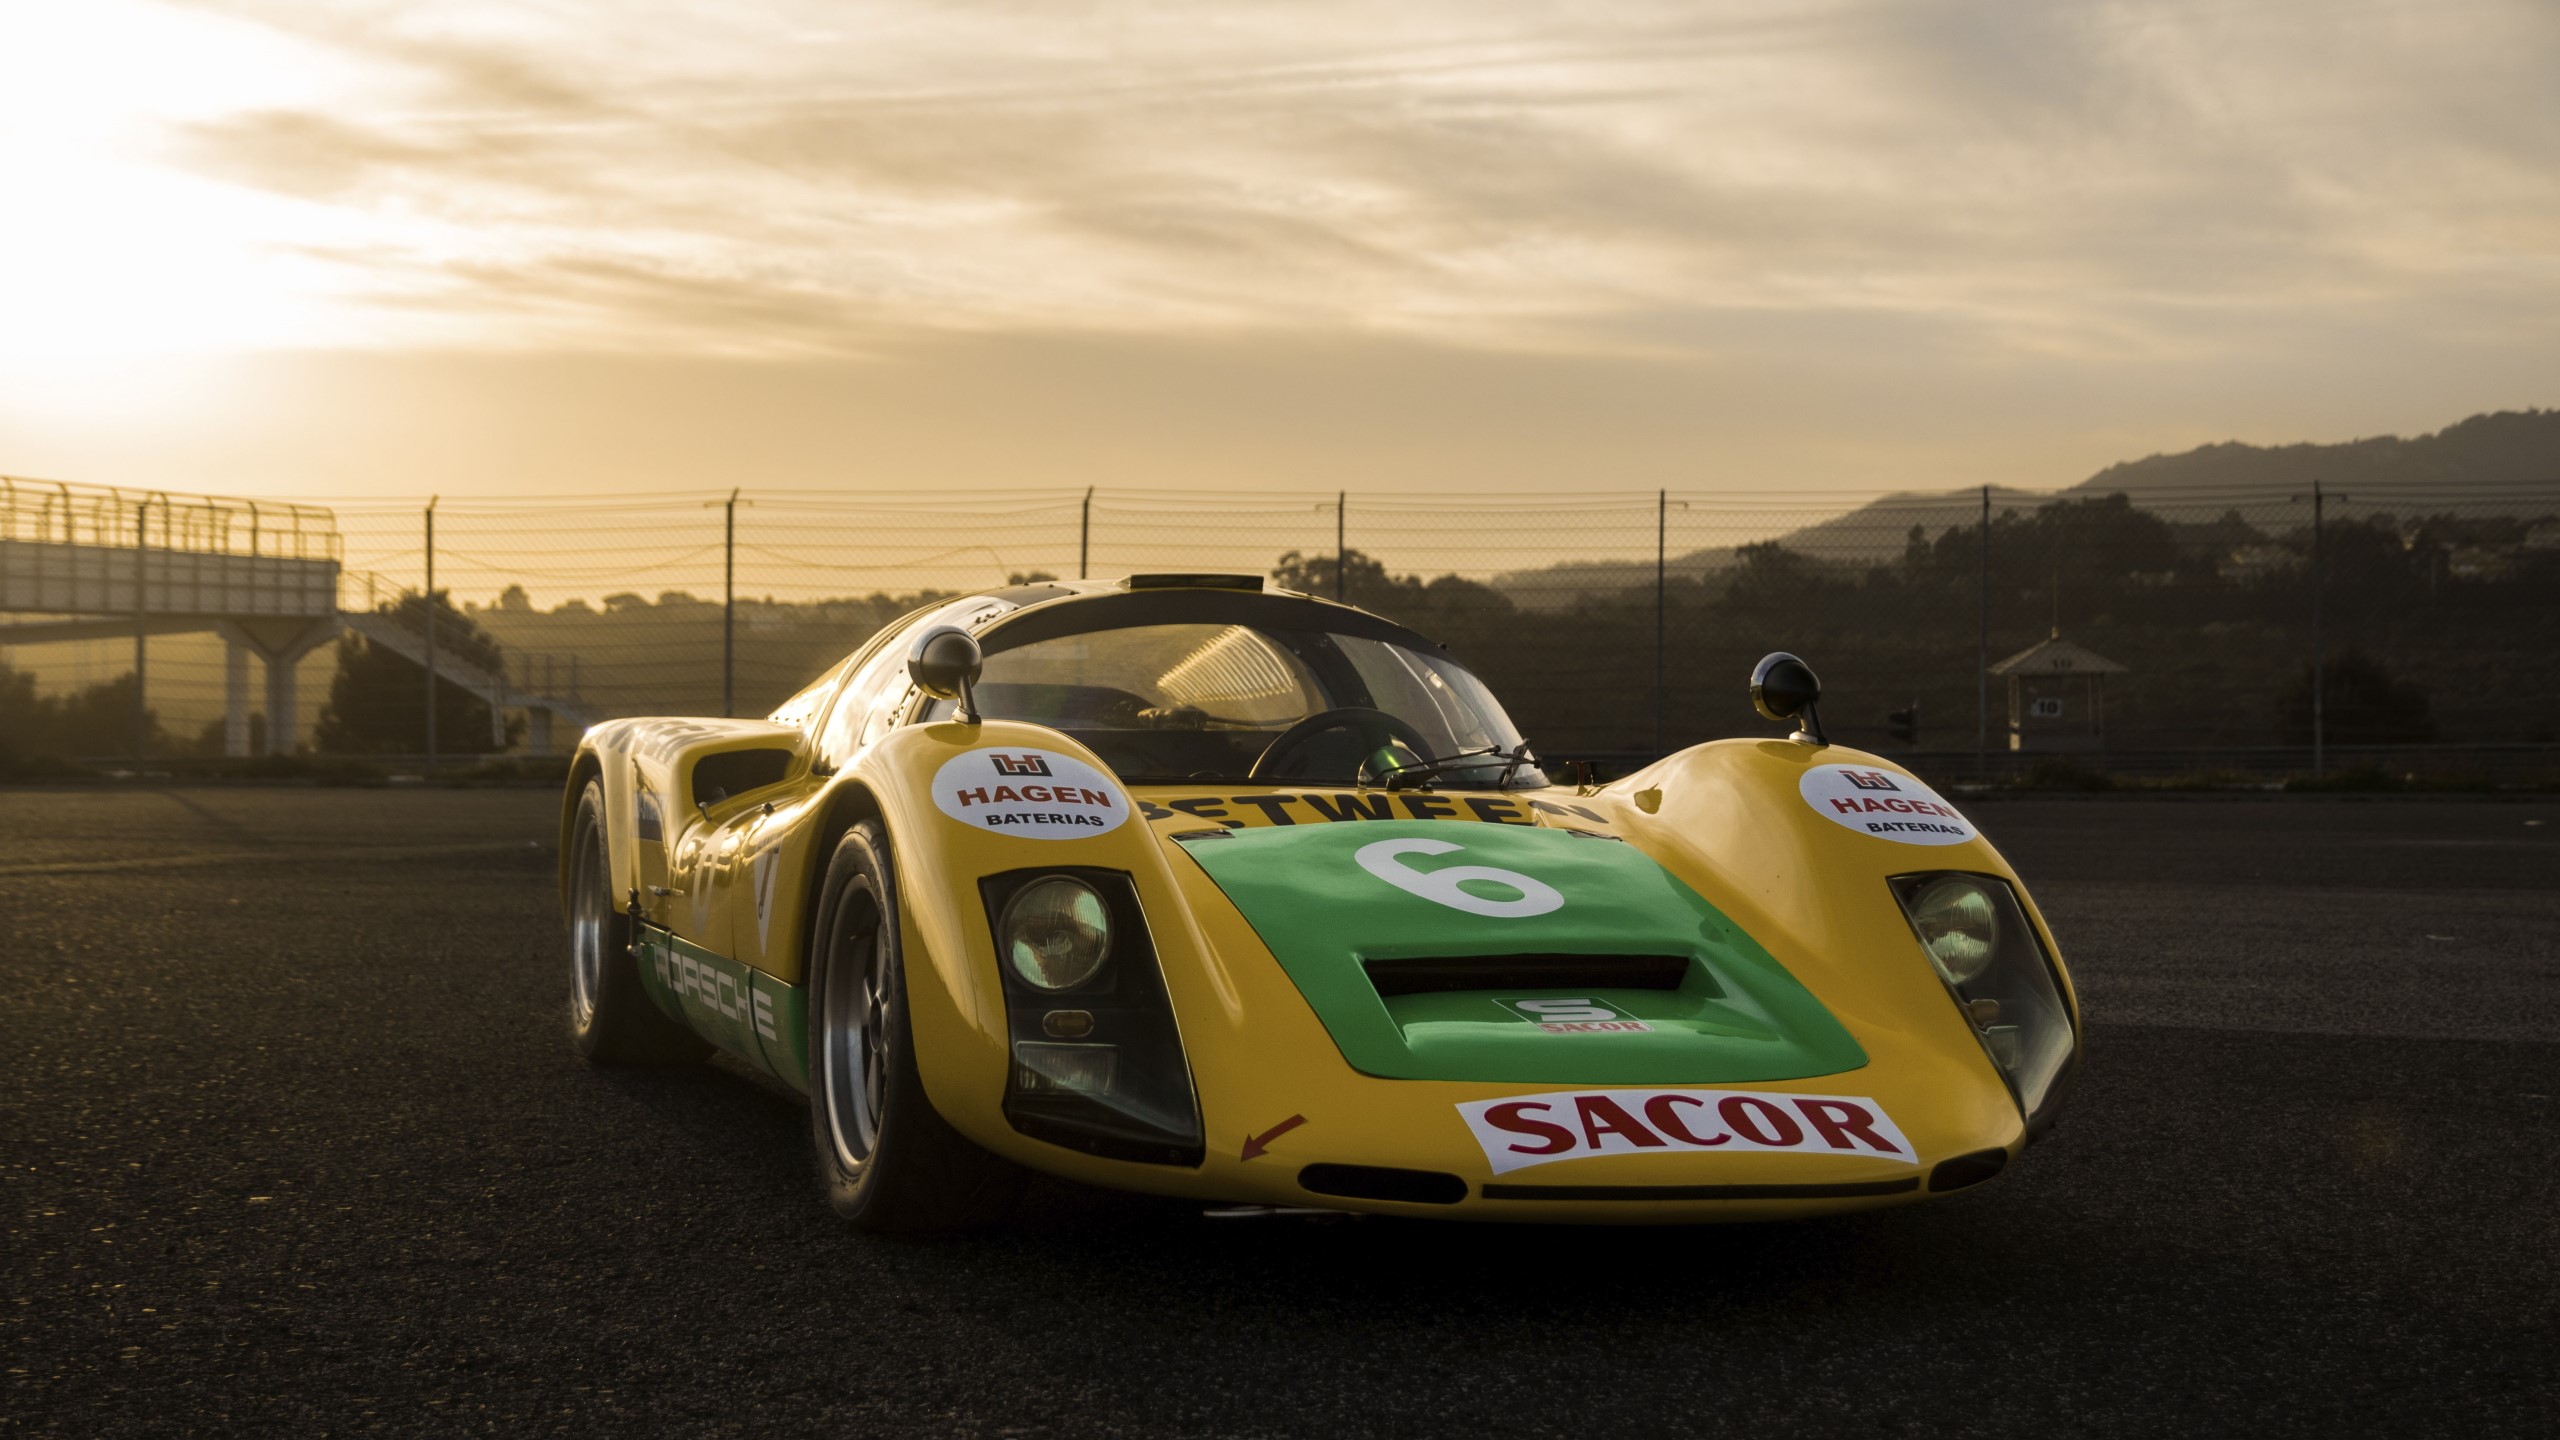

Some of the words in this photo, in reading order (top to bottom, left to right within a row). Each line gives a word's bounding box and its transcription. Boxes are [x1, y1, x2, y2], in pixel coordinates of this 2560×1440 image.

[2039, 702, 2058, 714] 10
[957, 785, 1112, 808] HAGEN
[1830, 797, 1959, 820] HAGEN
[986, 813, 1104, 827] BATERIAS
[1866, 822, 1965, 836] BATERIAS
[1354, 838, 1565, 918] 6
[1540, 1021, 1648, 1033] SACOR
[1484, 1095, 1904, 1155] SACOR
